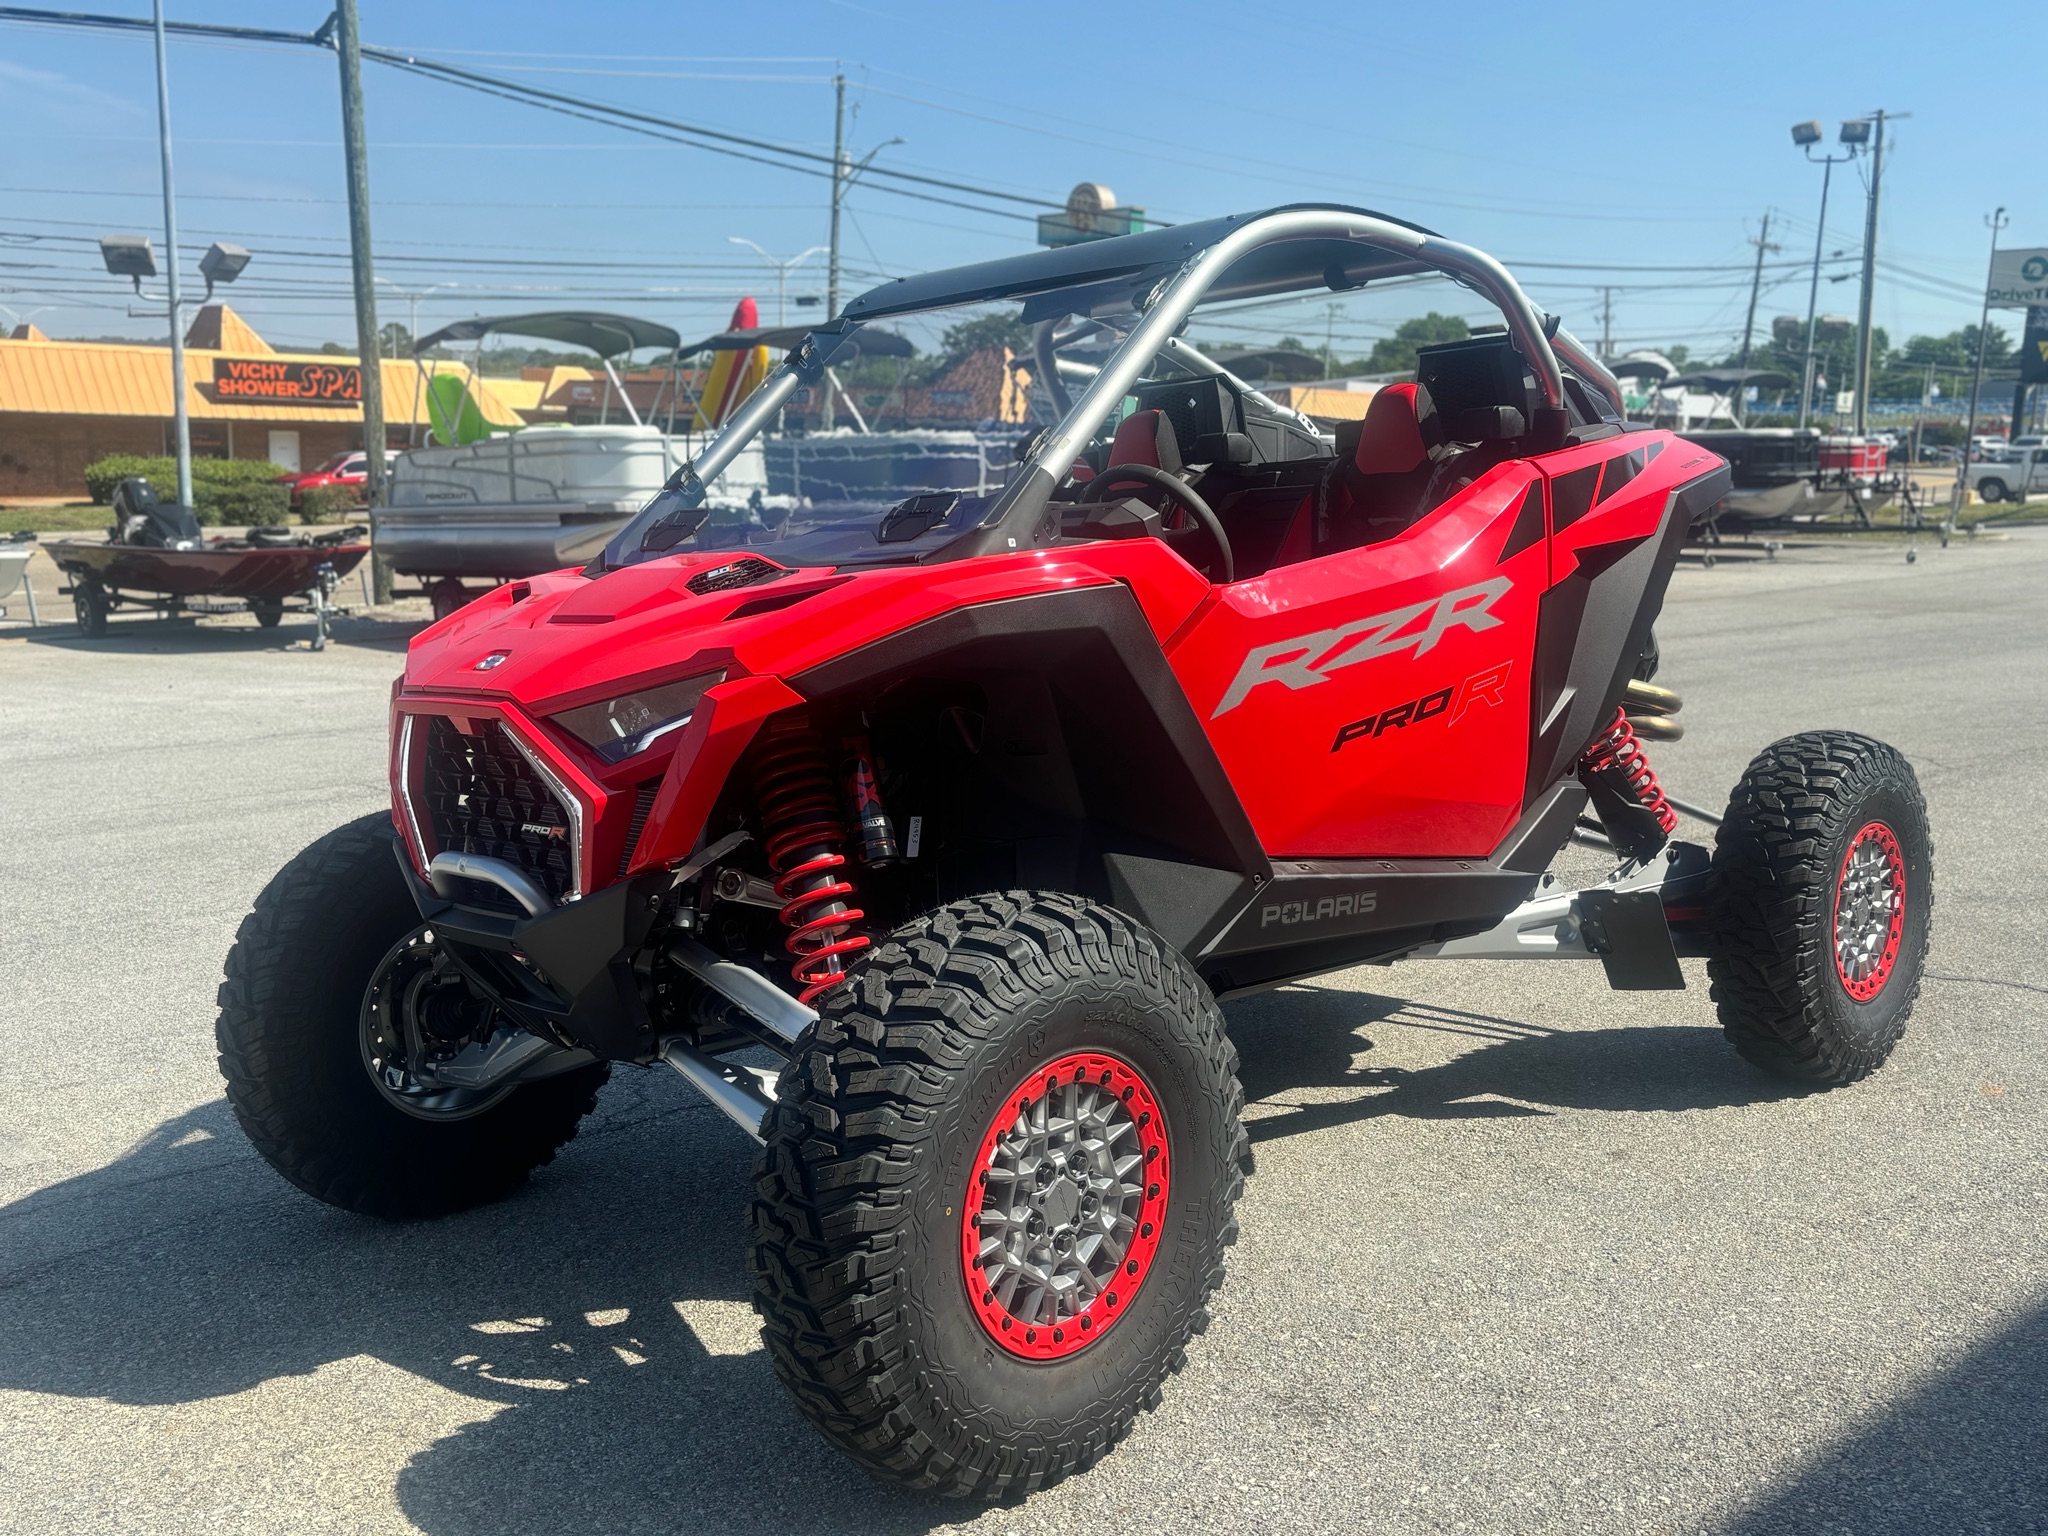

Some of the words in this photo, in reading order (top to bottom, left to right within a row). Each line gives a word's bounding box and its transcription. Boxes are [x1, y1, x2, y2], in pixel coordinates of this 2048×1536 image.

[218, 378, 300, 397] SHOWER
[300, 365, 362, 399] SPA
[228, 362, 288, 379] VICHY
[707, 563, 741, 579] 2.0L
[1210, 576, 1514, 720] RZR
[1261, 890, 1377, 927] POLARIS
